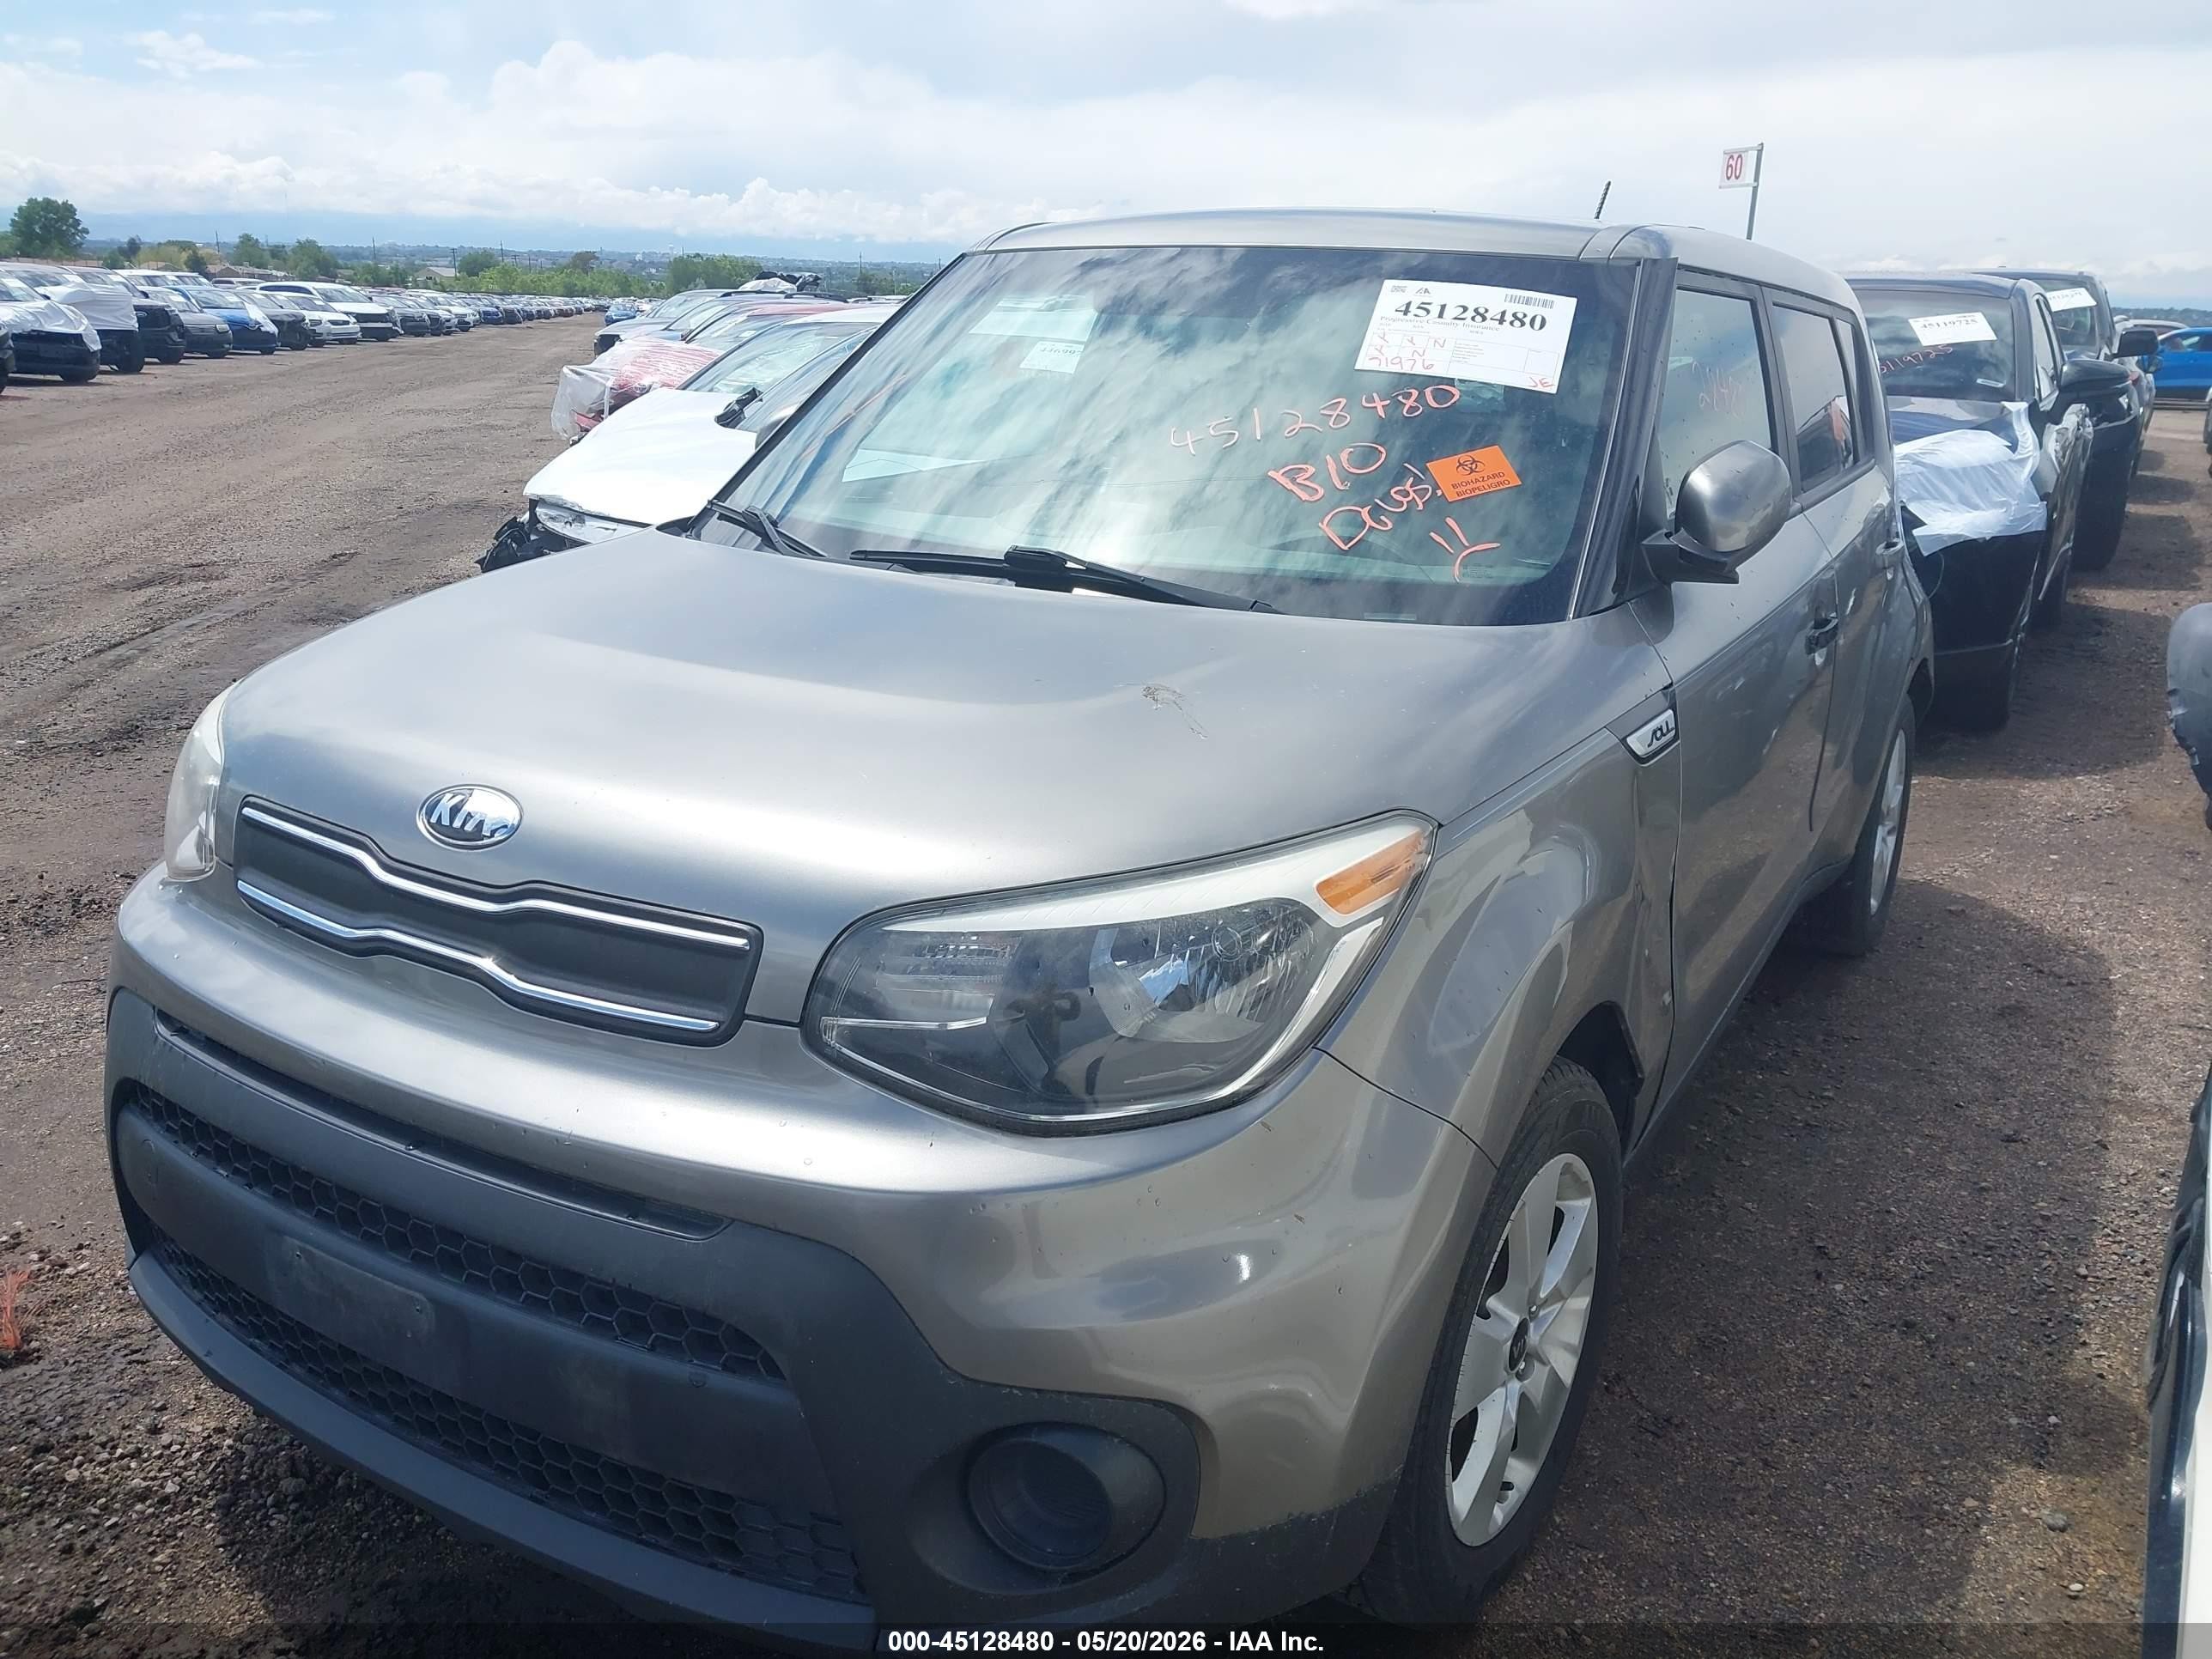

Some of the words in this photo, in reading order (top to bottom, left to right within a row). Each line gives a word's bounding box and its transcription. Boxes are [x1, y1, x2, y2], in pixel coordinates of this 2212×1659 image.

[1726, 154, 1742, 181] 60
[1395, 301, 1547, 331] 45128480
[1369, 356, 1434, 371] 71976
[1170, 385, 1460, 456] 45128480
[1267, 442, 1387, 501] BIO
[1451, 471, 1505, 489] BIOHAZARD
[1455, 479, 1510, 497] BIOPELIGRO
